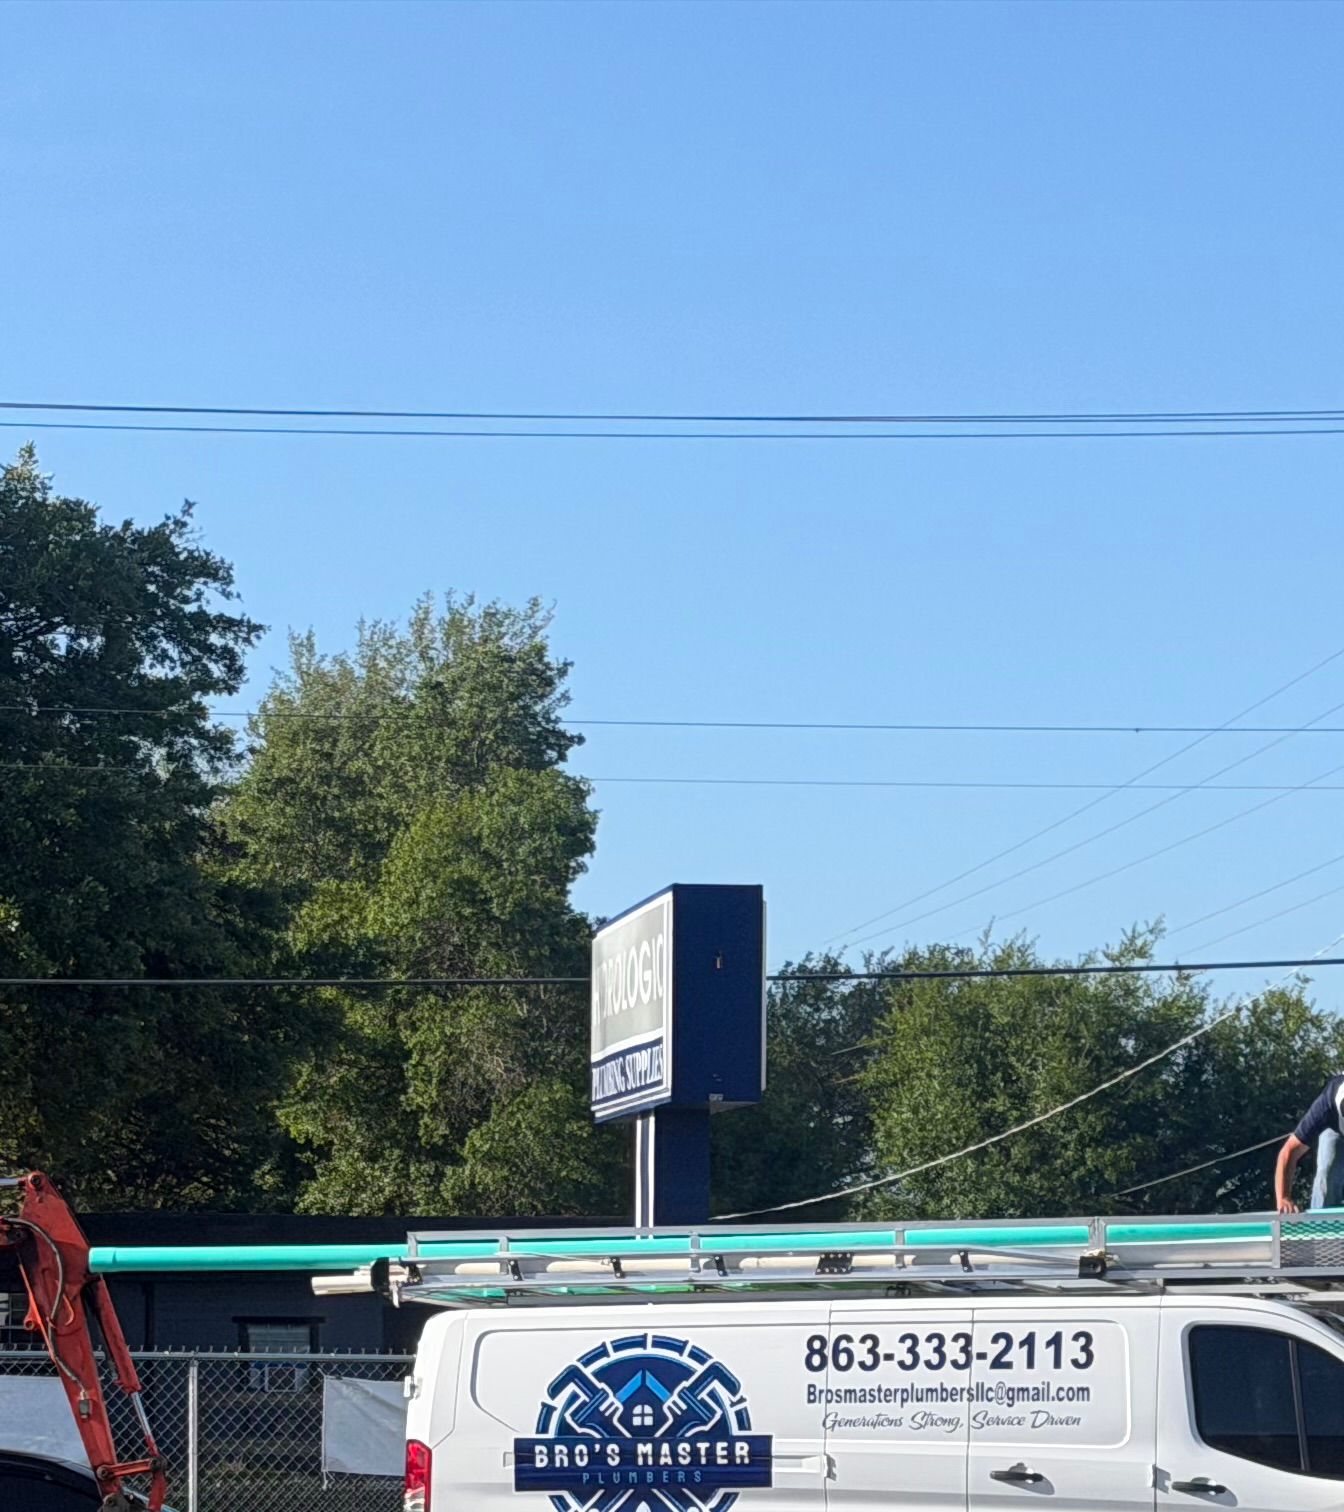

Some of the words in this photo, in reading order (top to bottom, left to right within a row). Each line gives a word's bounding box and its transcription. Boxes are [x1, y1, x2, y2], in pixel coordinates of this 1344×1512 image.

[592, 934, 664, 1025] HDROLOGIC
[625, 1044, 664, 1090] SUPPLIES
[805, 1331, 1094, 1372] 863-333-2113
[806, 1381, 1091, 1408] Brosmasterplumbersllc@gmail.com
[822, 1411, 904, 1432] Generations
[908, 1410, 964, 1433] Strong,
[970, 1410, 1026, 1430] Service
[1030, 1410, 1082, 1429] Driven
[534, 1443, 620, 1468] BRO'S
[637, 1442, 750, 1466] MASTER
[582, 1470, 702, 1485] PLUMBERS
